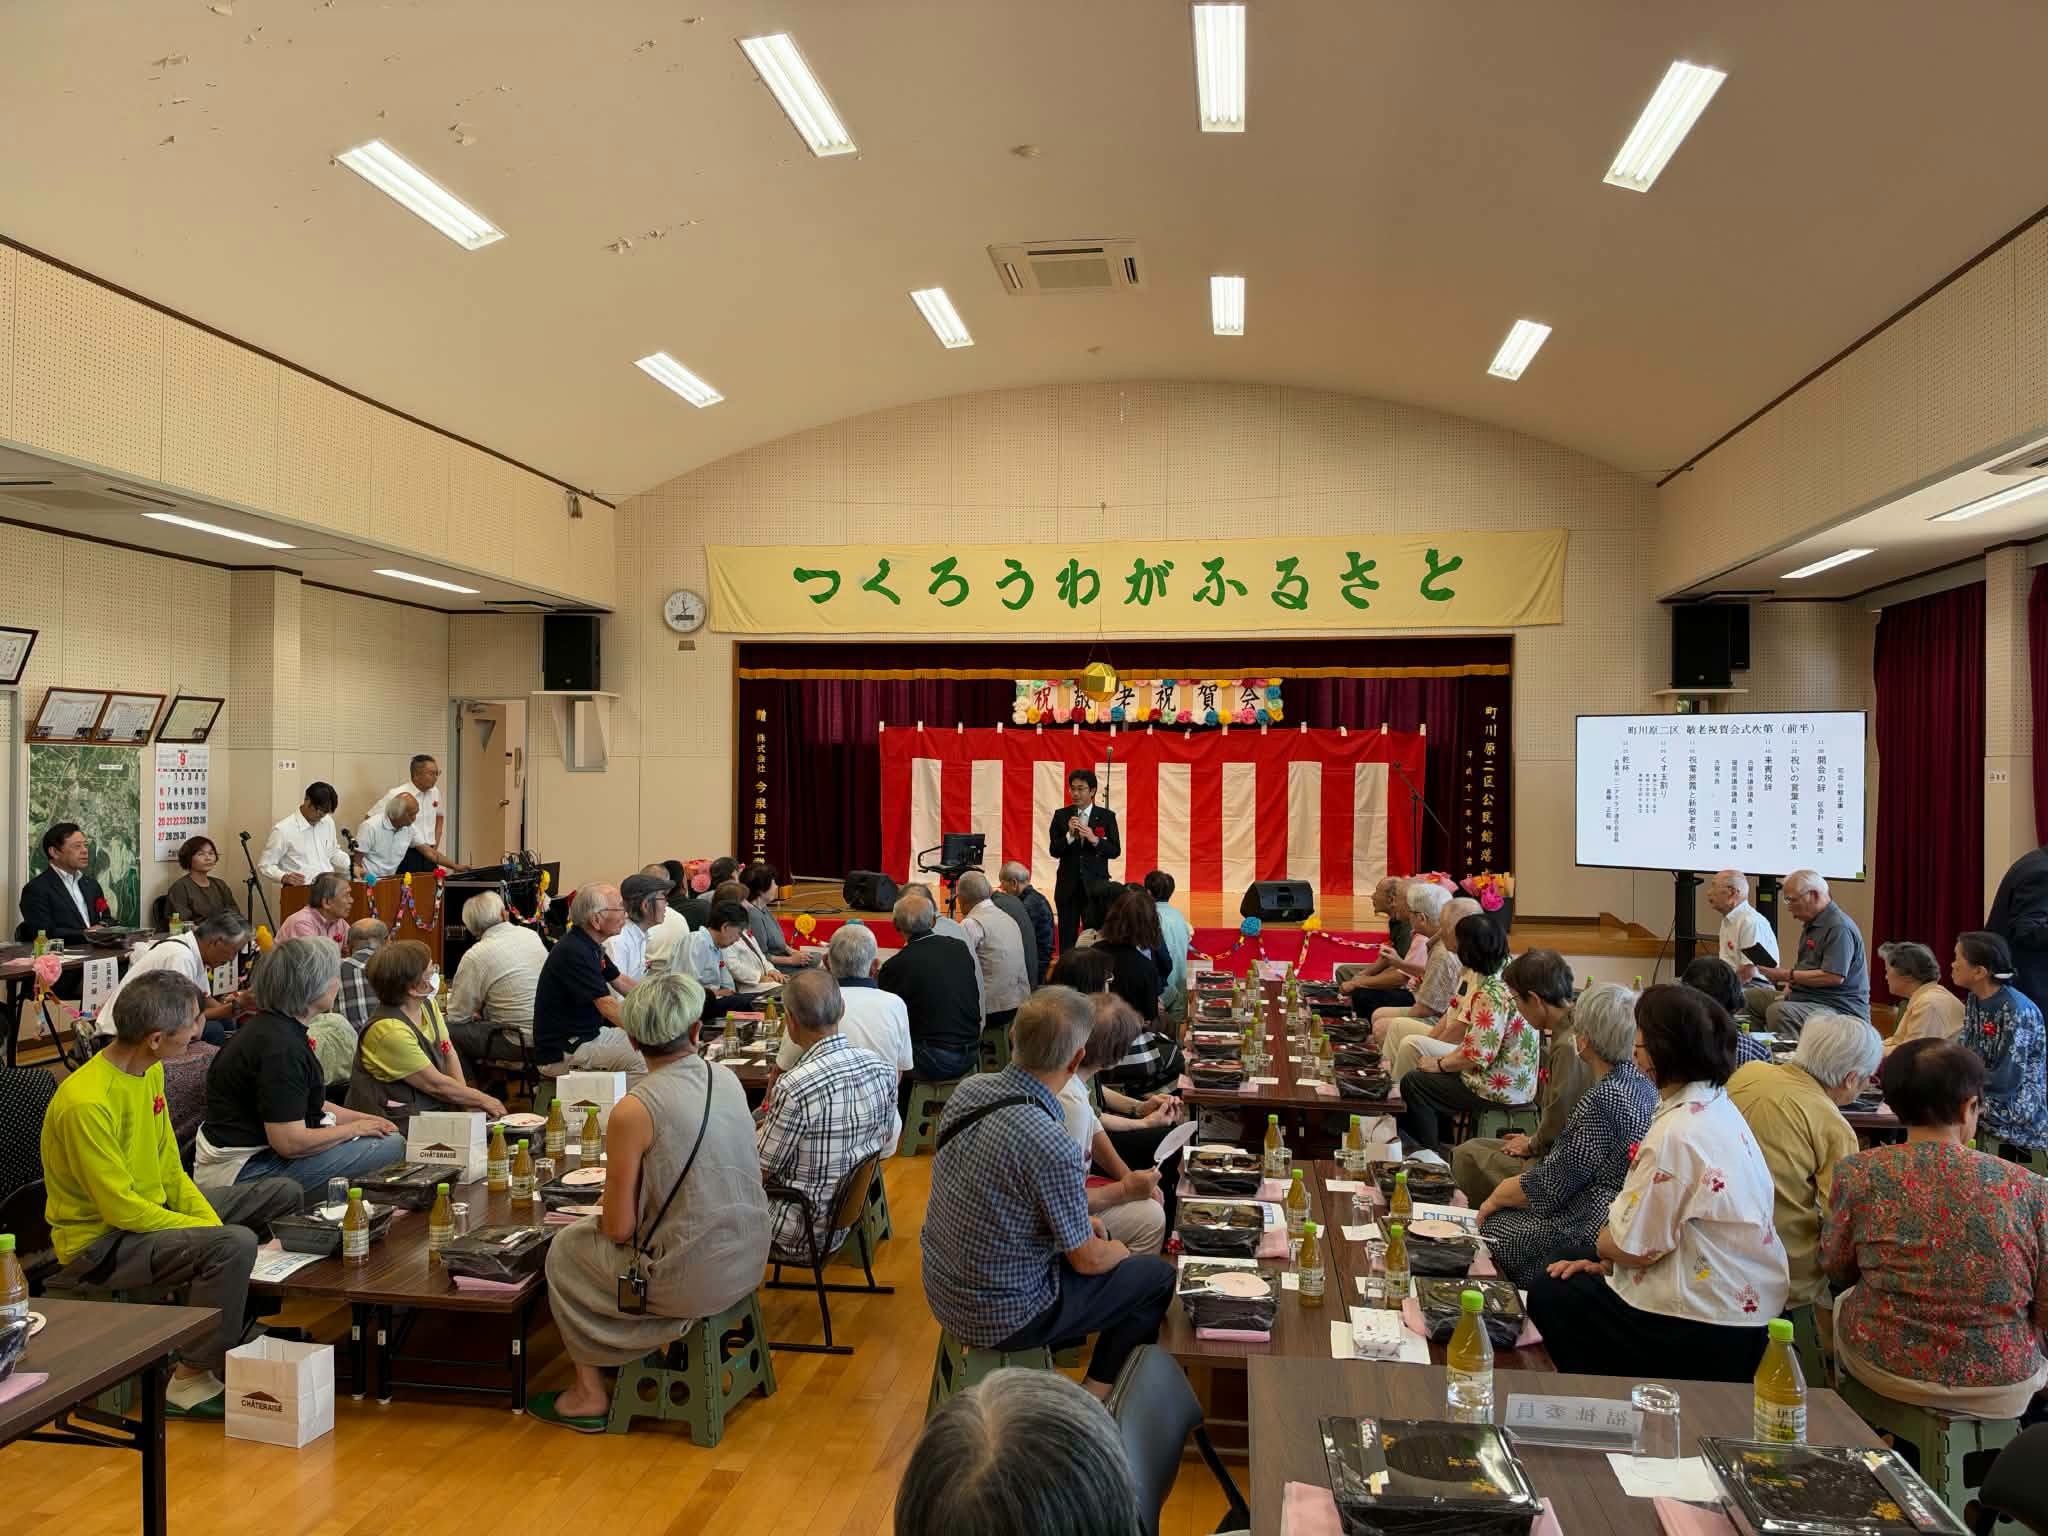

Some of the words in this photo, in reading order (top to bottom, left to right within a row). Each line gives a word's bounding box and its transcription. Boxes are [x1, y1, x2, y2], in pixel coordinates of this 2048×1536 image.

[792, 548, 1464, 611] つくろうわがふるさと
[1627, 724, 1679, 736] 町川原二区
[756, 733, 767, 773] 株式会社
[1764, 756, 1773, 791] 来賓祝辞
[1790, 756, 1800, 801] 祝いの言葉
[1816, 756, 1826, 792] 開会の辞
